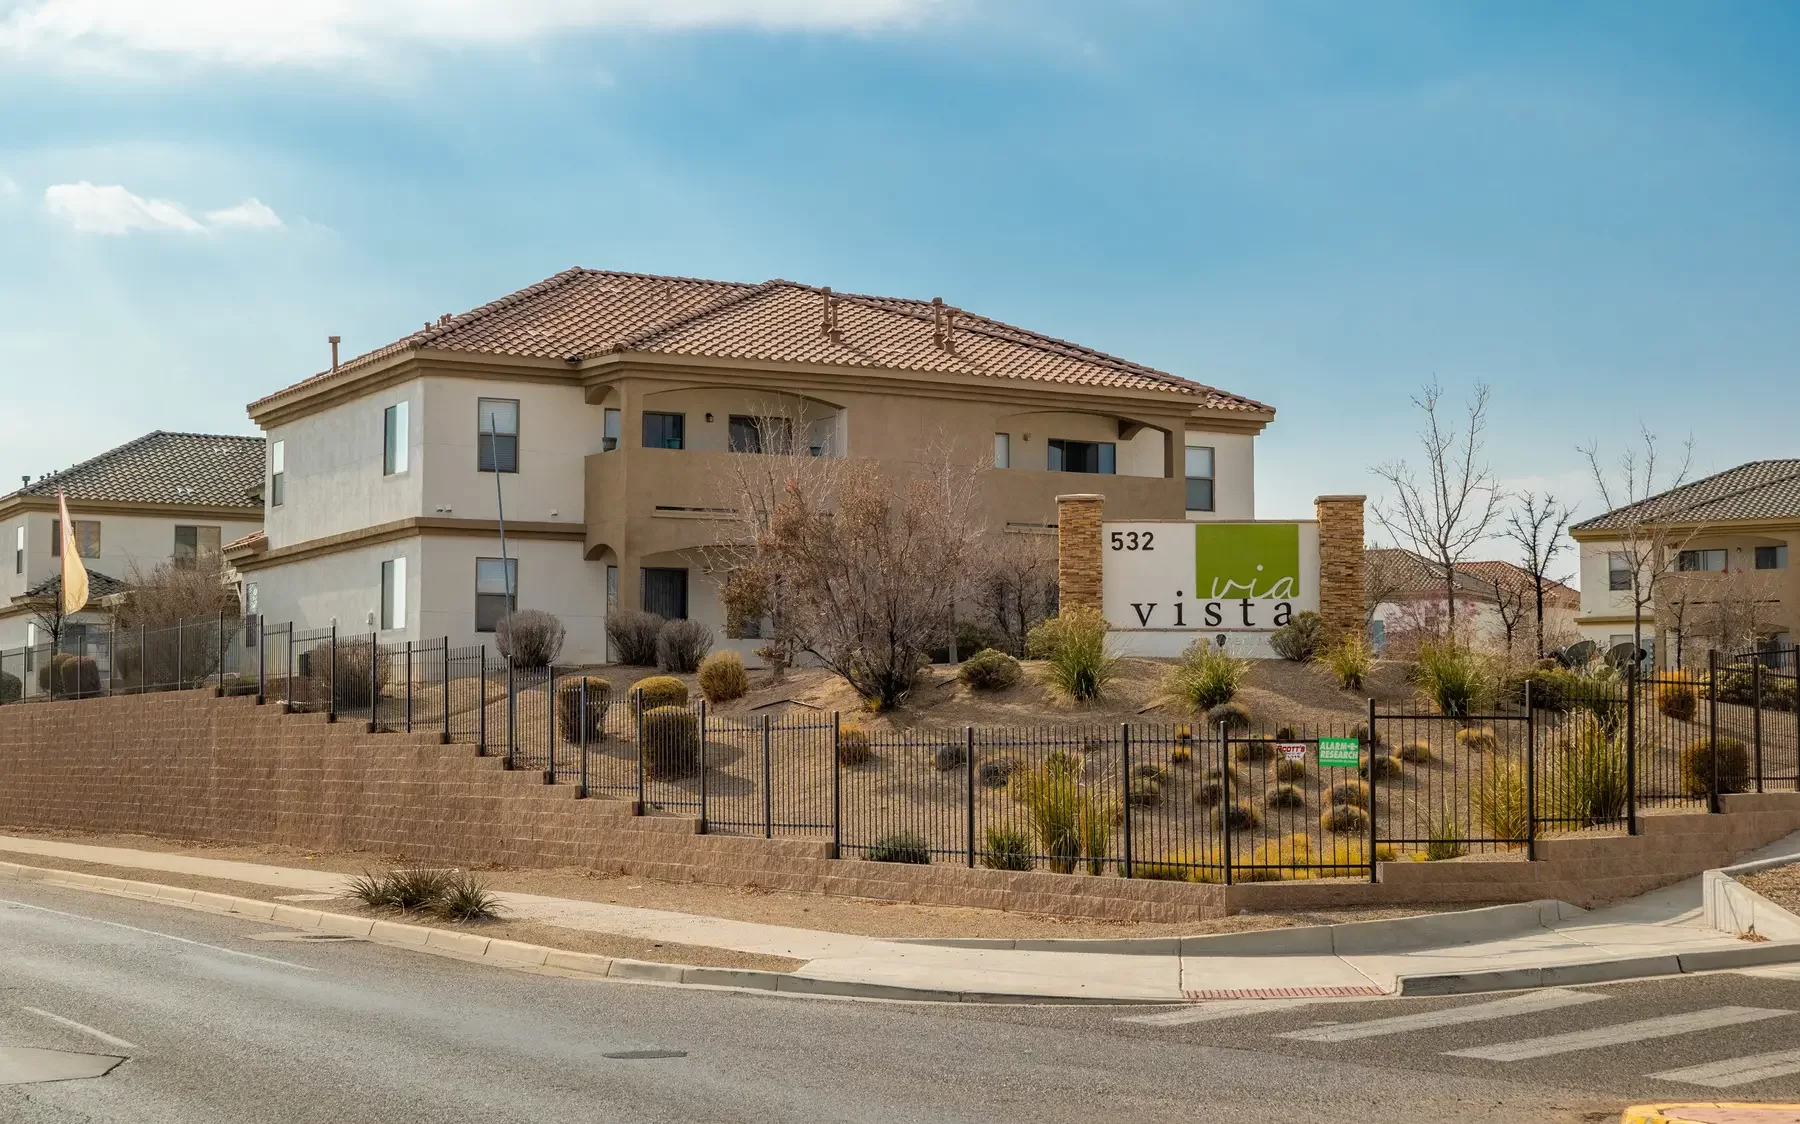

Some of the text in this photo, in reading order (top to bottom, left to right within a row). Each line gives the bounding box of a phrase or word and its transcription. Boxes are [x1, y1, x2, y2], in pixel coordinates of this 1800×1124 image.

[1111, 531, 1154, 551] 532
[1211, 564, 1299, 600] via
[1130, 590, 1292, 627] vista
[1320, 742, 1347, 750] ALARM
[1320, 751, 1358, 759] RESEARCH
